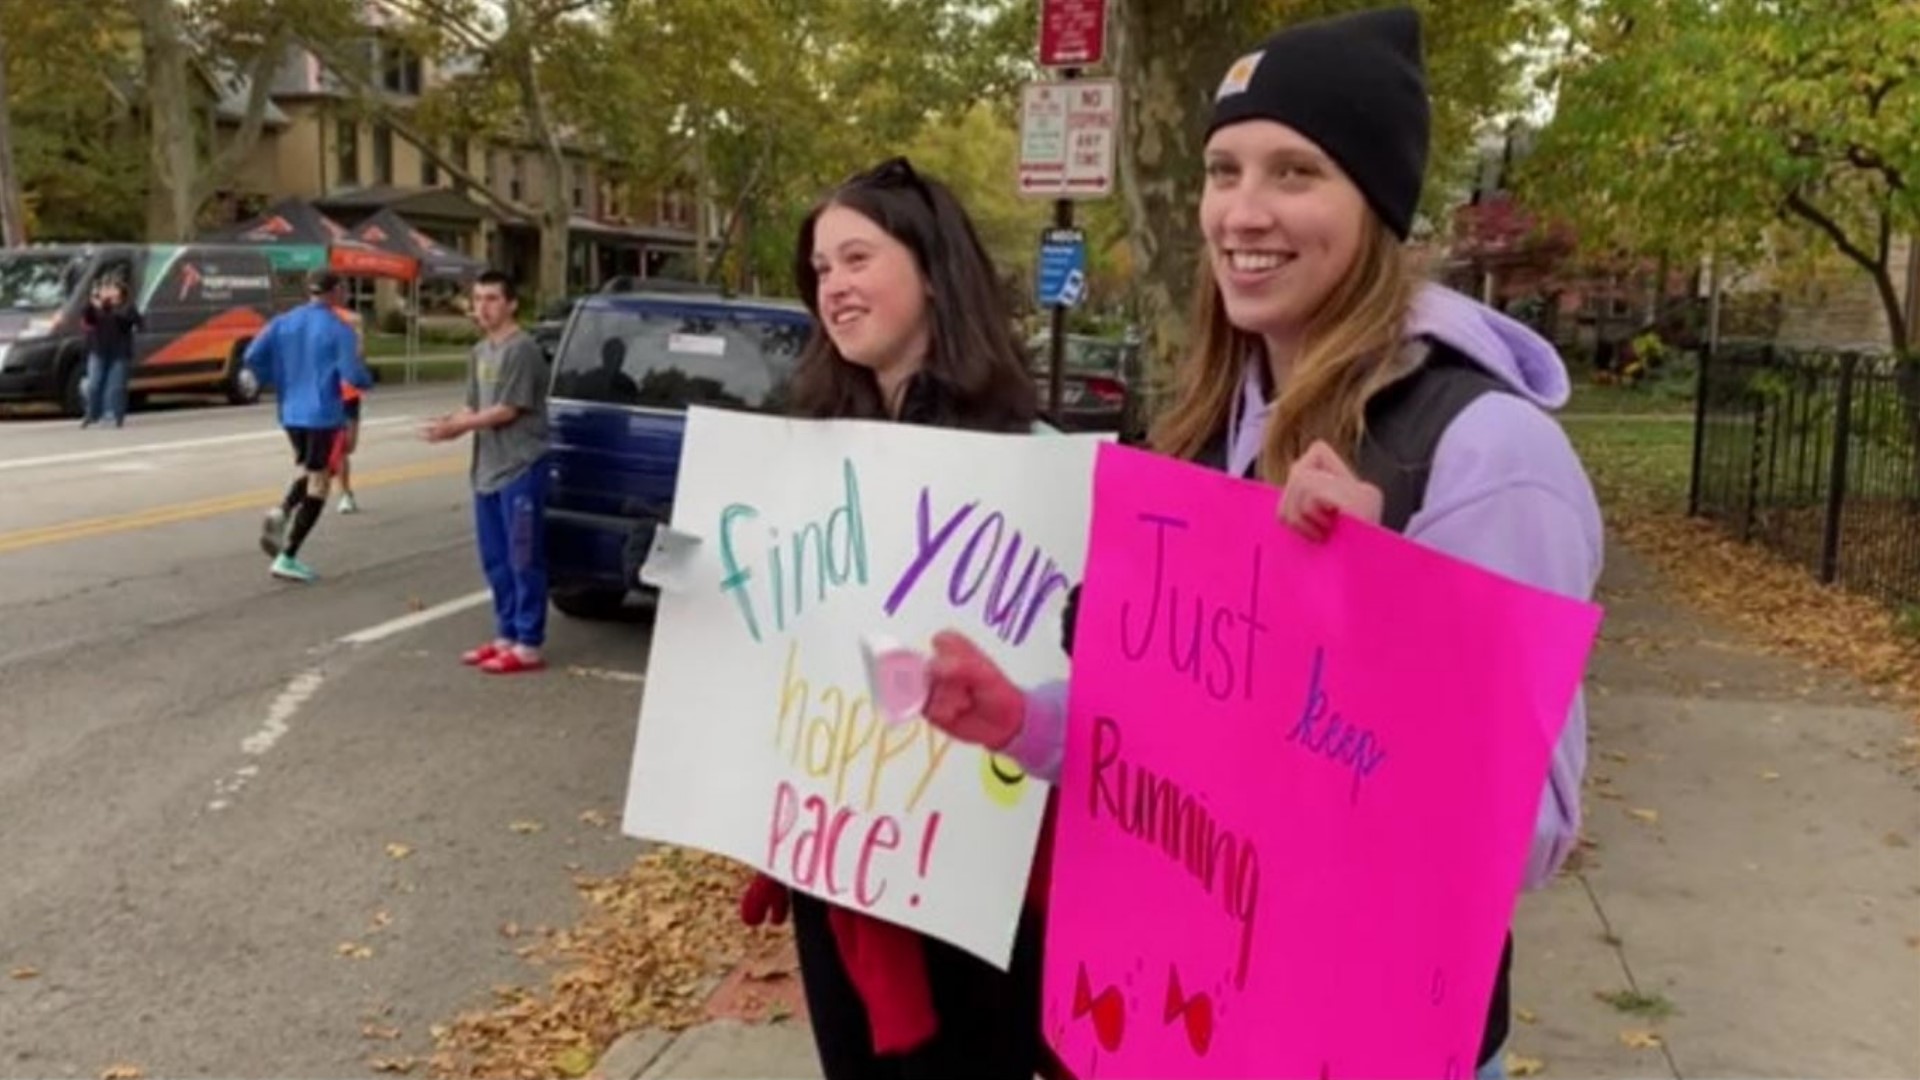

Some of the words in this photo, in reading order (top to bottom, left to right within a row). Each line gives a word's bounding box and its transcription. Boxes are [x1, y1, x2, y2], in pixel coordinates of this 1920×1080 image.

[1076, 134, 1101, 148] ANY
[1082, 90, 1101, 107] NO
[720, 457, 868, 642] find
[1120, 513, 1268, 704] Just
[774, 639, 954, 814] happy
[1088, 715, 1260, 992] Running
